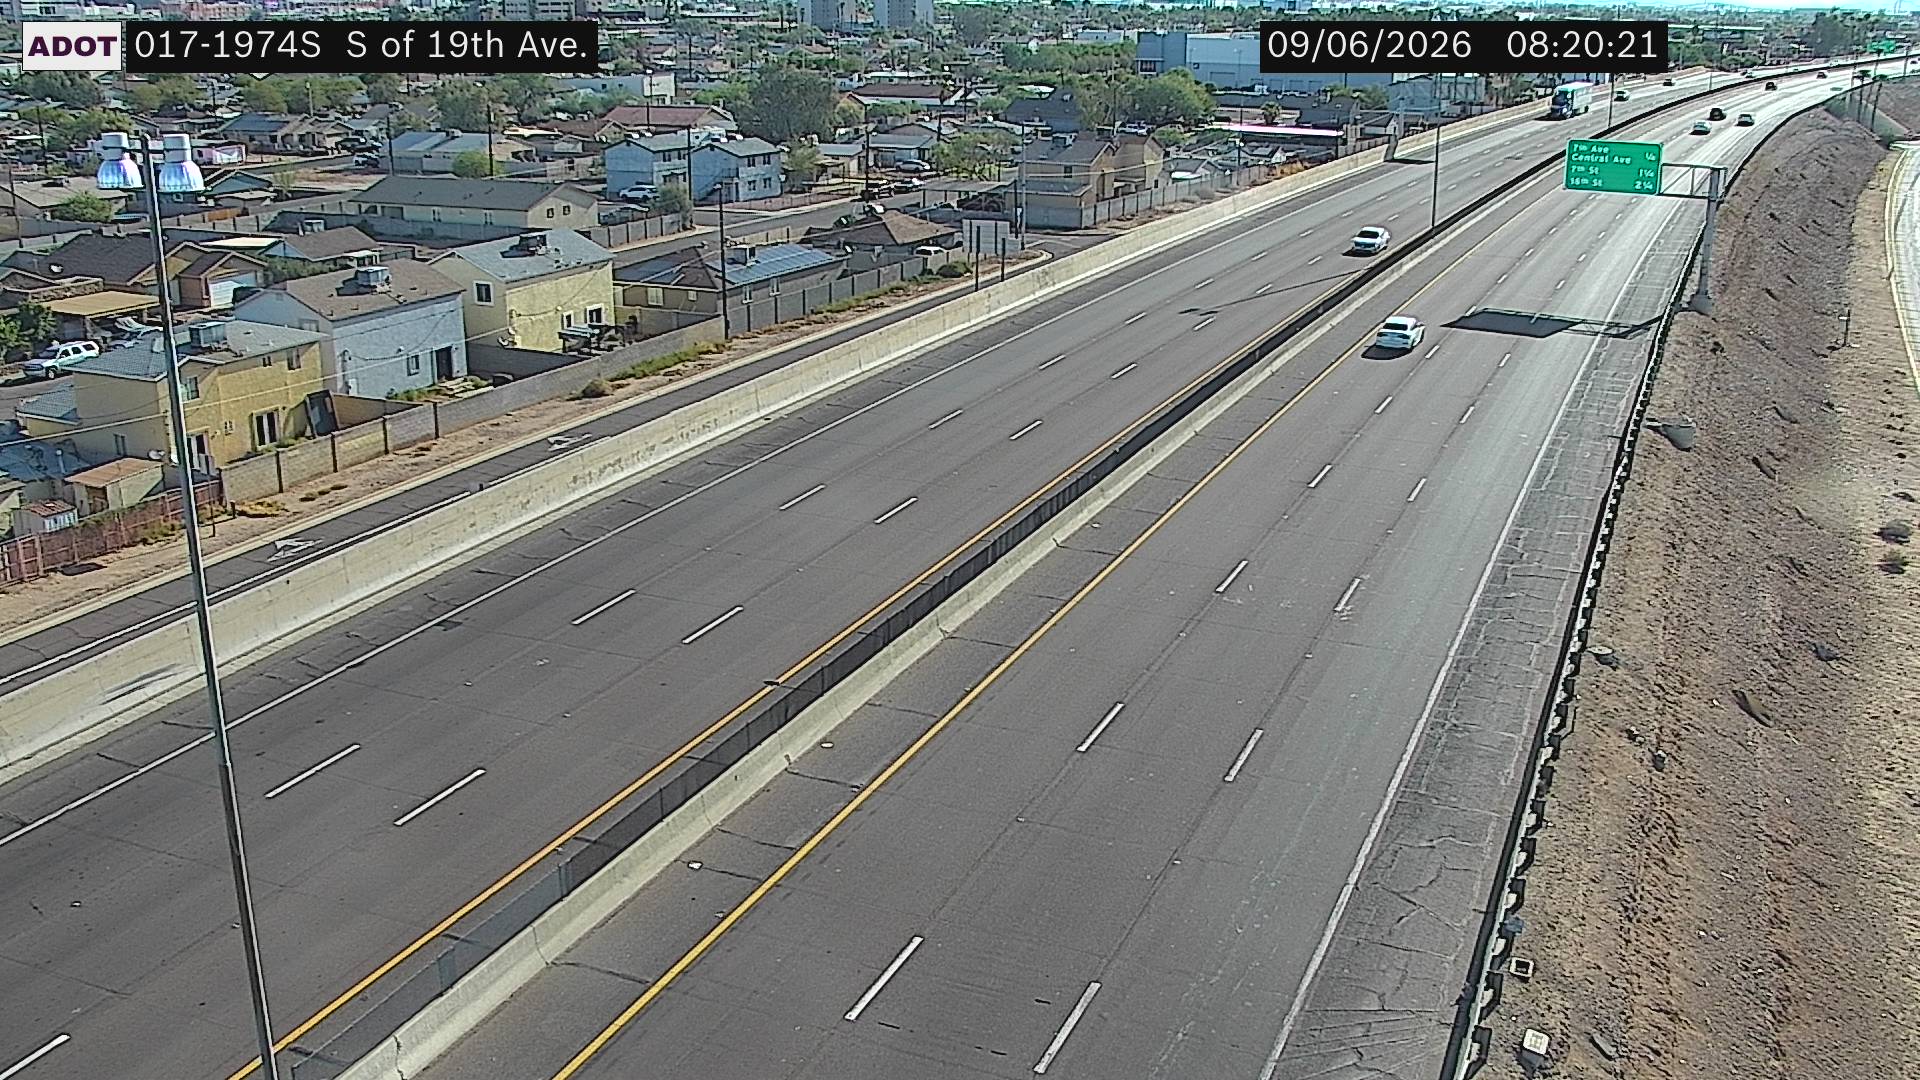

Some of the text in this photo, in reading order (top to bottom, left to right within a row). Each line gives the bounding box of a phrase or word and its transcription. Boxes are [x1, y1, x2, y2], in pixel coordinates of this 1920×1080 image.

[1573, 144, 1609, 153] 7th Ave
[1571, 153, 1631, 164] Central Ave
[1588, 166, 1599, 175] St
[1592, 179, 1603, 187] St
